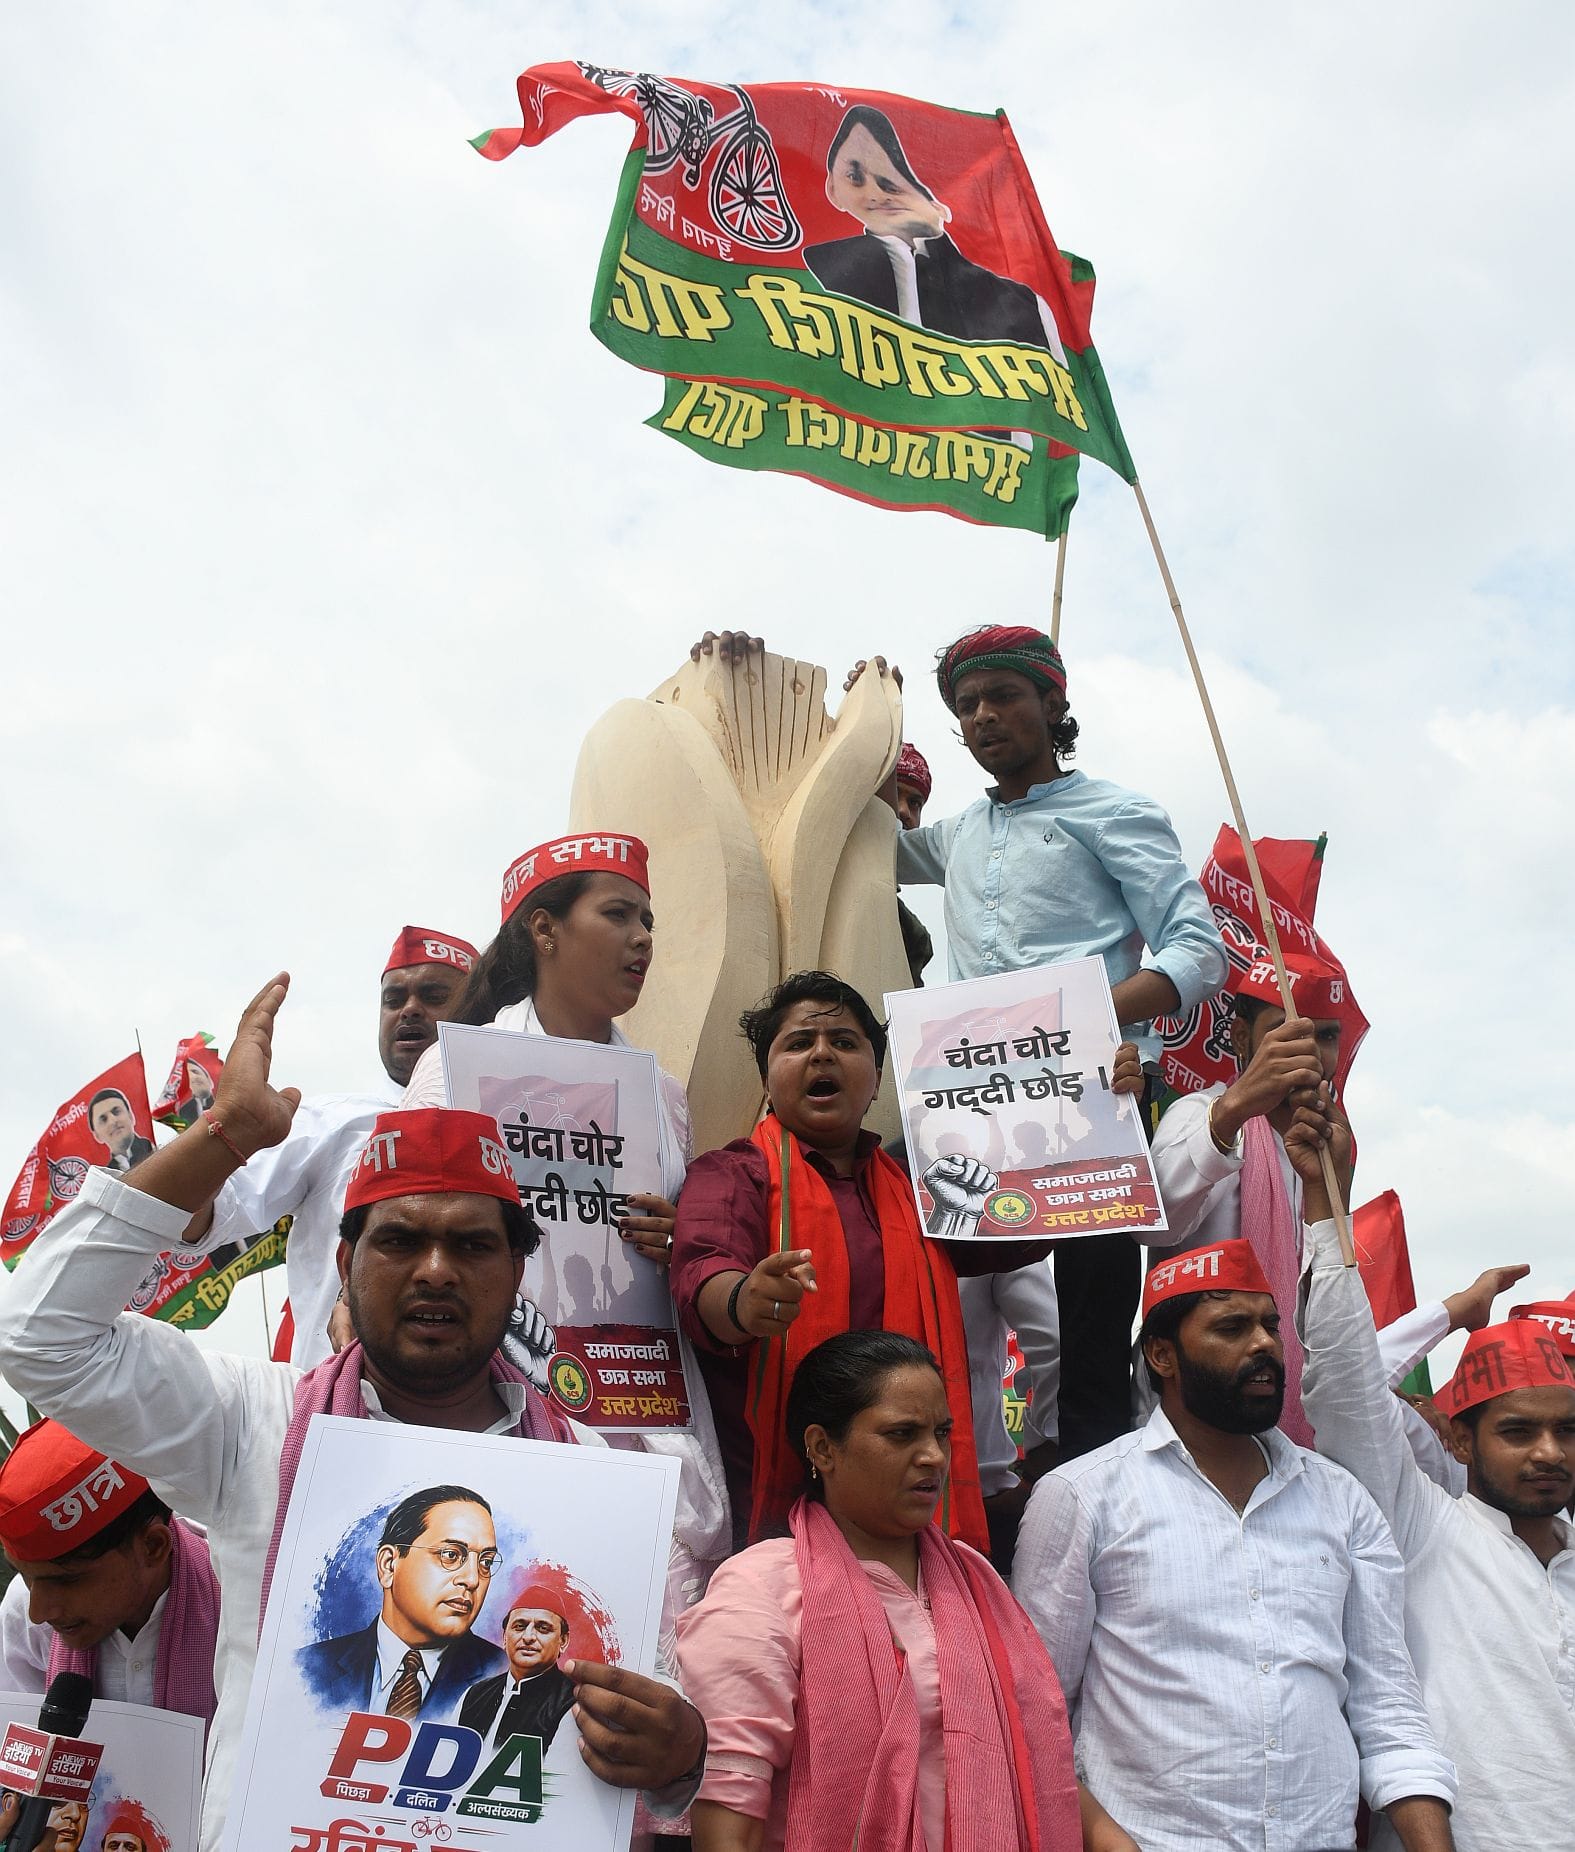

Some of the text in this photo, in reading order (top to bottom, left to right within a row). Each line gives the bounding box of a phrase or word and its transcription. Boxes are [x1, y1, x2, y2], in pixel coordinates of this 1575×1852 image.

[502, 836, 633, 904] छात्र सभा
[1208, 859, 1256, 914] यादव
[422, 939, 473, 970] छात्र
[944, 1025, 1072, 1071] चंदा चोर
[1020, 1067, 1084, 1103] छोड़
[1165, 1054, 1207, 1092] चुनाव
[502, 1111, 625, 1169] चंदा चोर
[1031, 1163, 1138, 1190] समाजवादी
[1045, 1184, 1132, 1206] छात्र सभा
[1041, 1201, 1146, 1227] उत्तर प्रदेश
[1150, 1249, 1225, 1293] सभा
[584, 1340, 670, 1361] समाजवादी
[597, 1369, 667, 1387] छात्र सभा
[597, 1390, 680, 1418] उत्तर प्रदेश
[39, 1457, 127, 1532] छात्र
[13, 1741, 44, 1757] NEWS TV
[62, 1754, 97, 1767] NEWS TV
[326, 1710, 544, 1807] PDA
[53, 1776, 67, 1784] Your
[335, 1781, 530, 1820] पिछड़ा दलित अल्पसंख्यक
